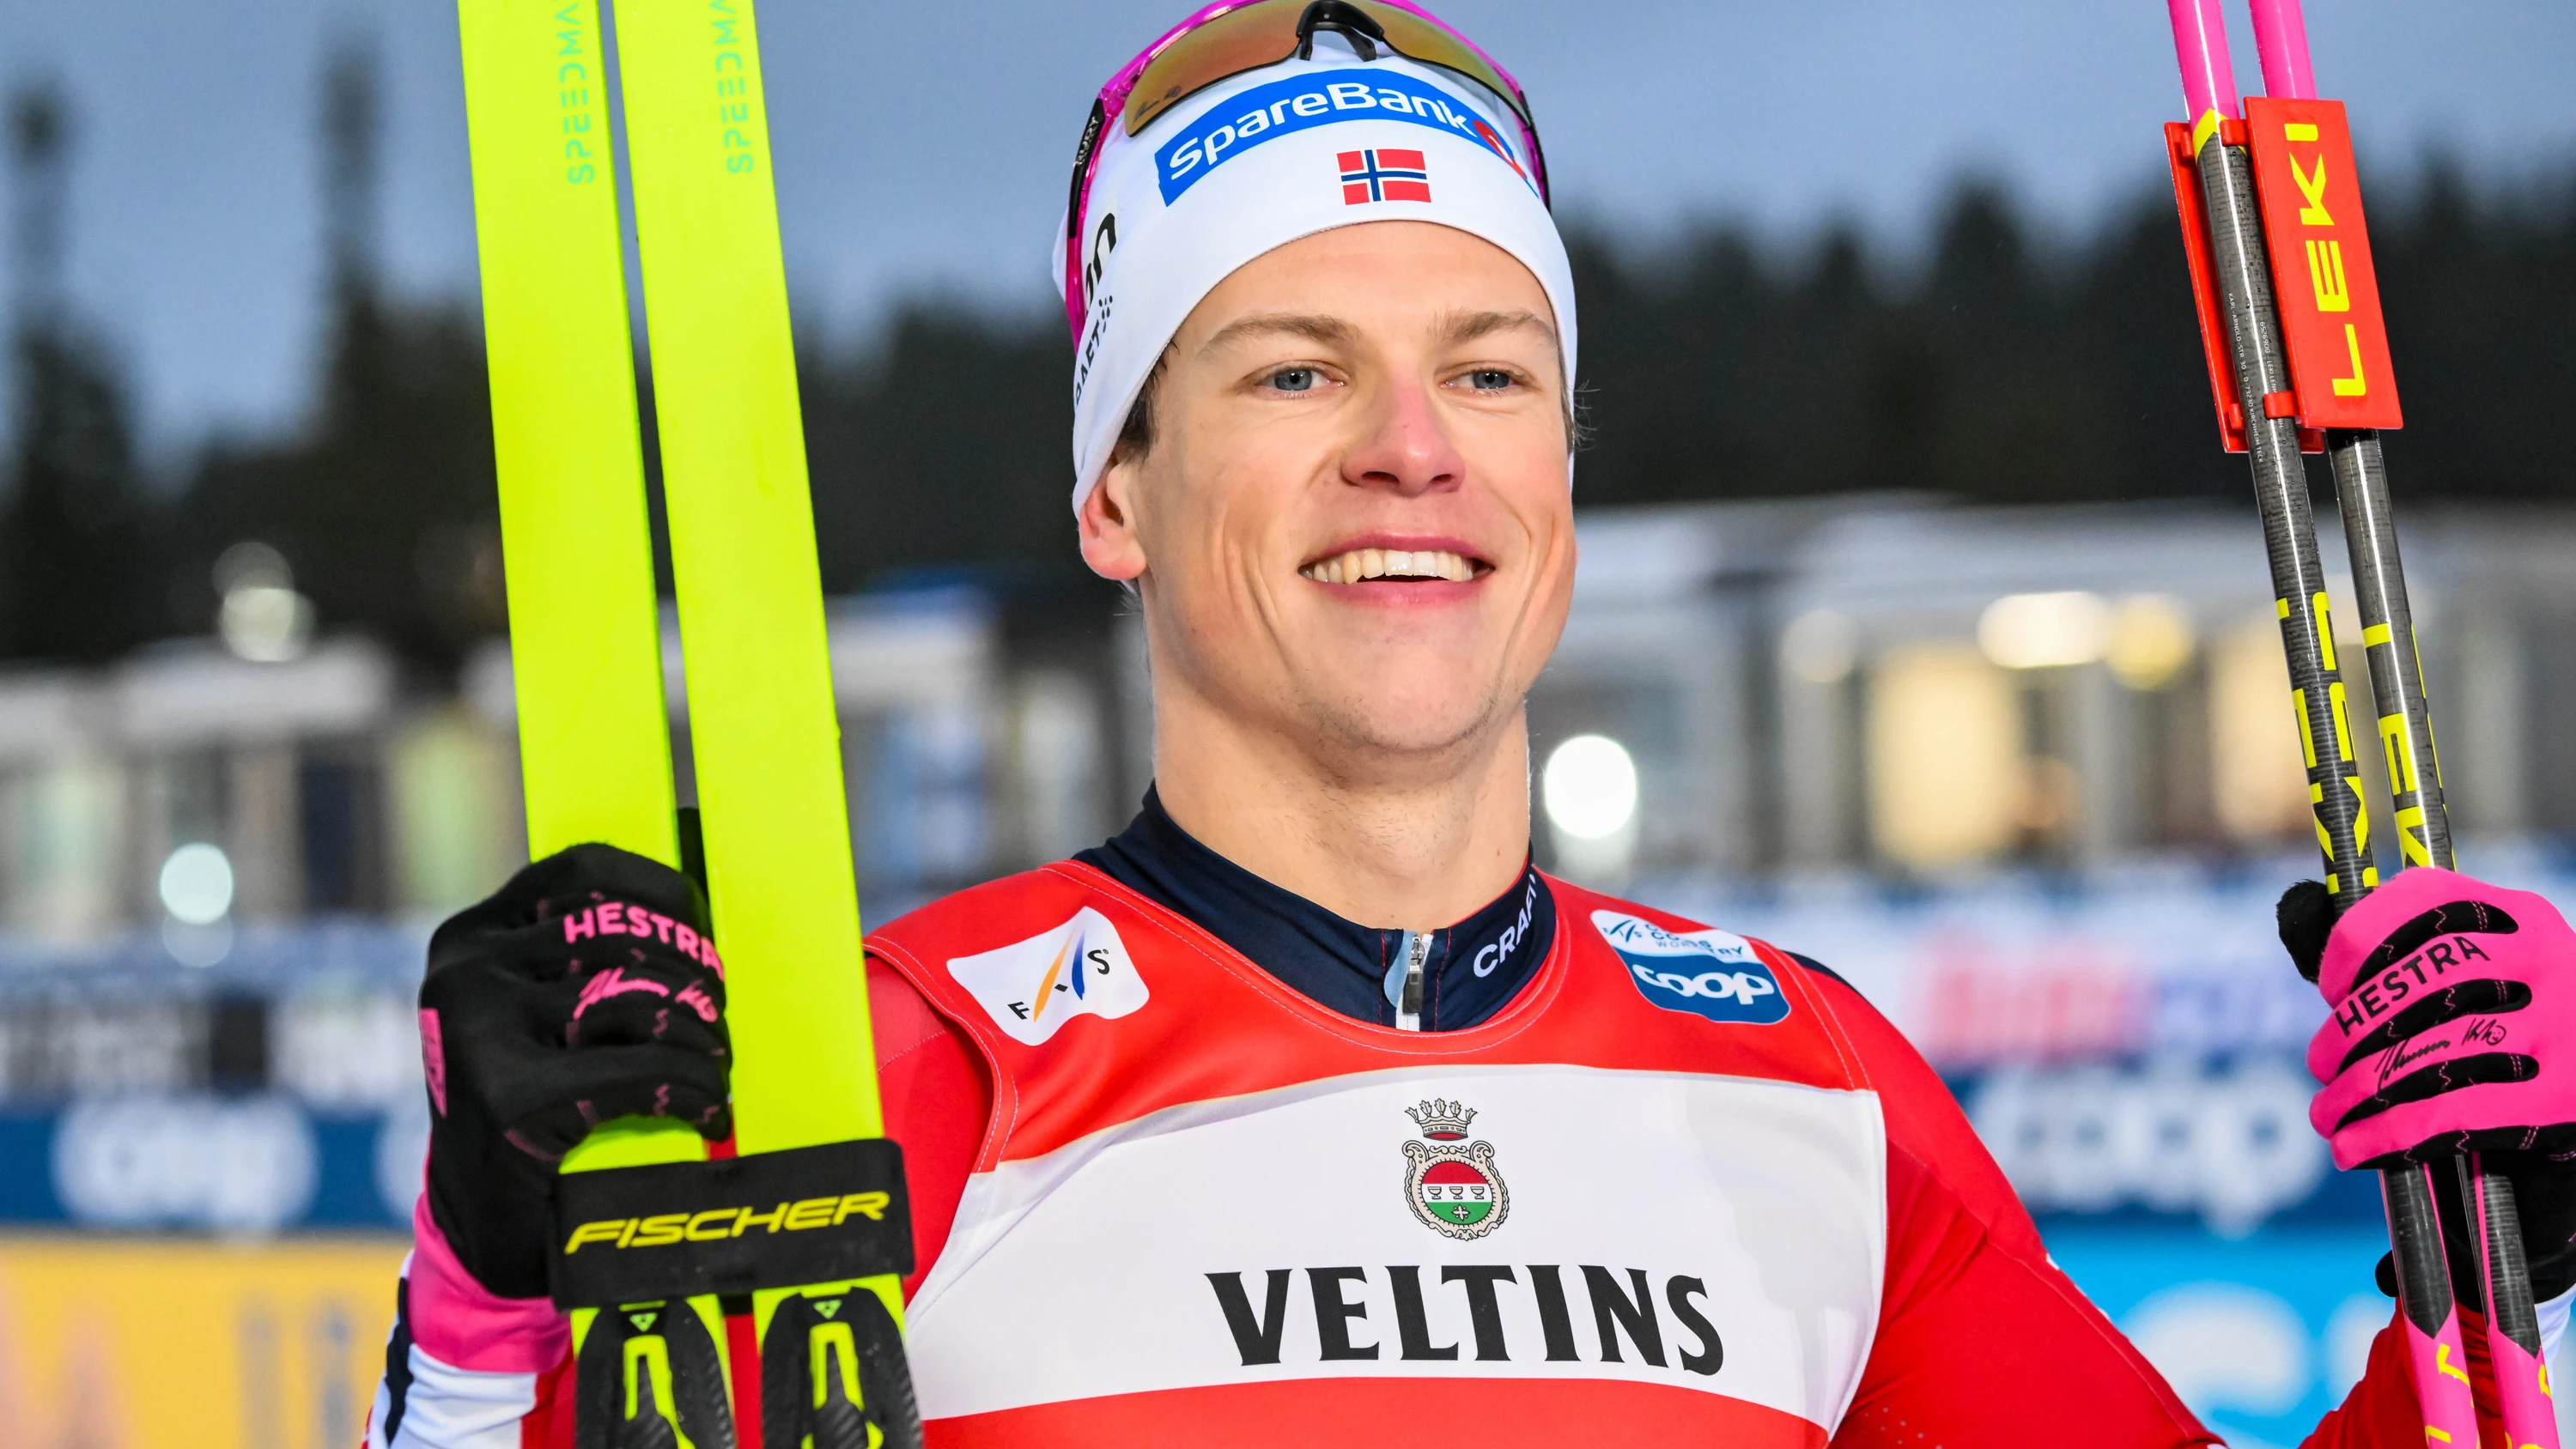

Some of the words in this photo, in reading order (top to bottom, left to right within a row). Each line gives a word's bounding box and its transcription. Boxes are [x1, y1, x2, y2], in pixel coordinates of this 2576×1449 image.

[1169, 82, 1478, 180] SpareBank
[2284, 124, 2366, 396] LEKI
[562, 901, 726, 983] HESTRA
[1632, 963, 1775, 1005] coop
[2335, 936, 2491, 1037] HESTRA
[564, 1191, 890, 1255] FISCHER
[1204, 1264, 1724, 1377] VELTINS
